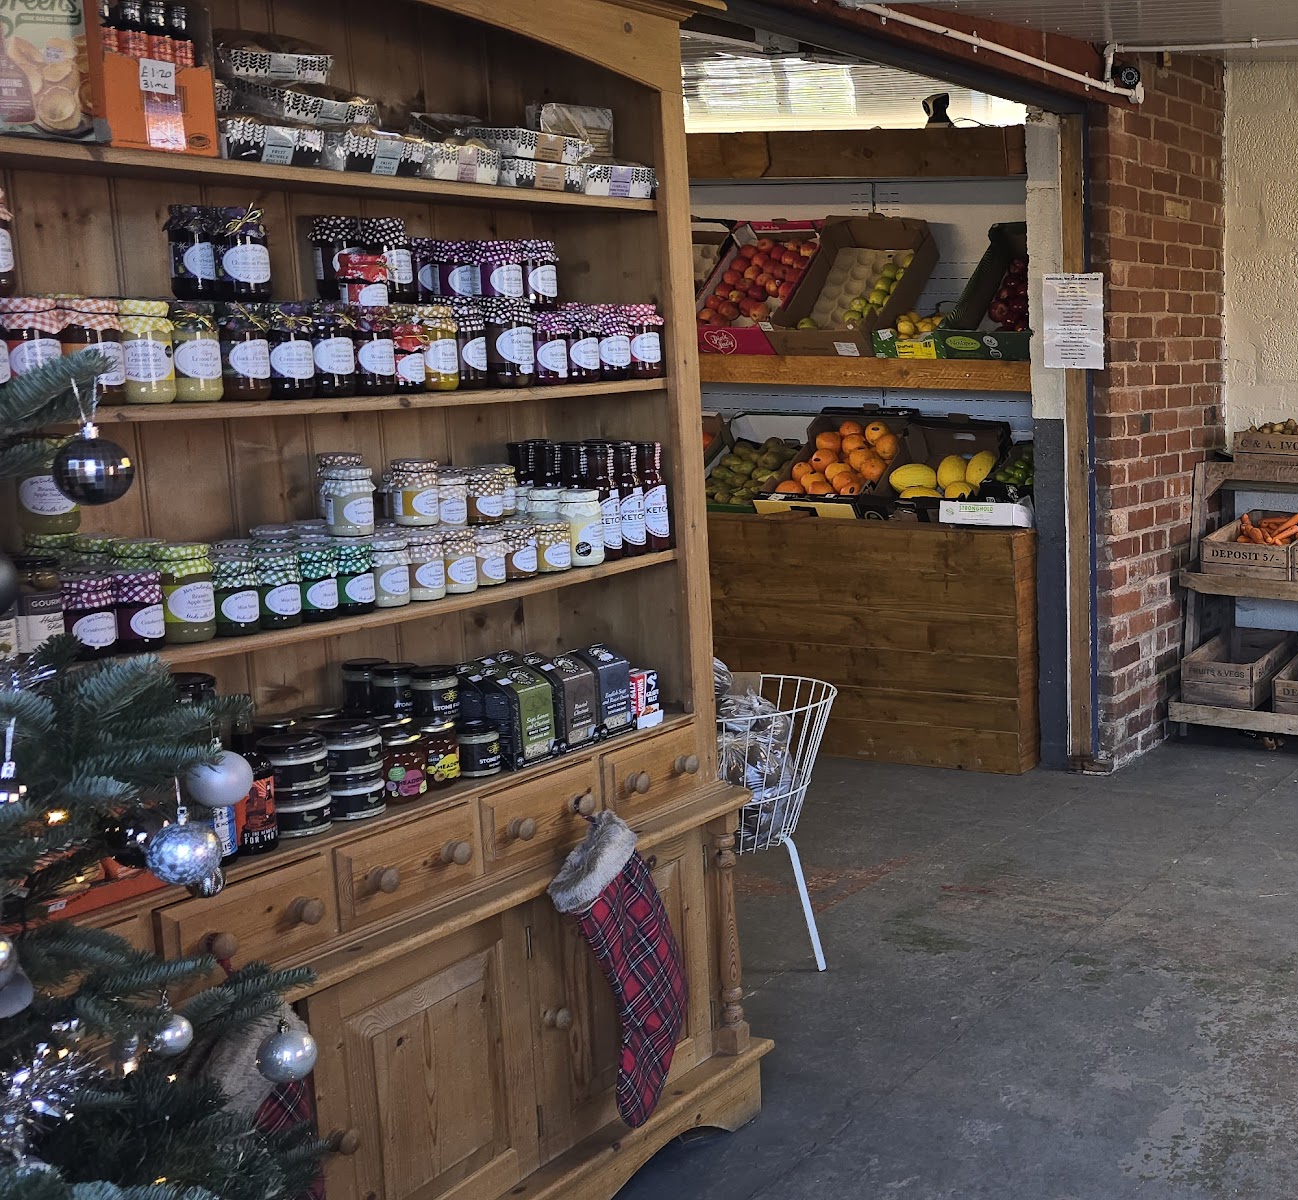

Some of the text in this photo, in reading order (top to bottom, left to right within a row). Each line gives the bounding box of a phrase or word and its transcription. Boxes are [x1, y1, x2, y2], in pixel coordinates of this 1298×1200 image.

[2, 88, 17, 98] MIX
[711, 332, 728, 344] Pink
[718, 339, 734, 349] Lady
[1240, 438, 1249, 448] C
[1252, 439, 1262, 448] &
[1264, 440, 1276, 450] A.
[959, 504, 994, 513] STRONGHOLD
[1211, 549, 1280, 562] DEPOSIT 5/-
[1188, 667, 1245, 679] FRUITS & VEGS
[433, 703, 450, 712] STONE
[479, 757, 495, 765] STONE
[244, 835, 260, 845] FOR
